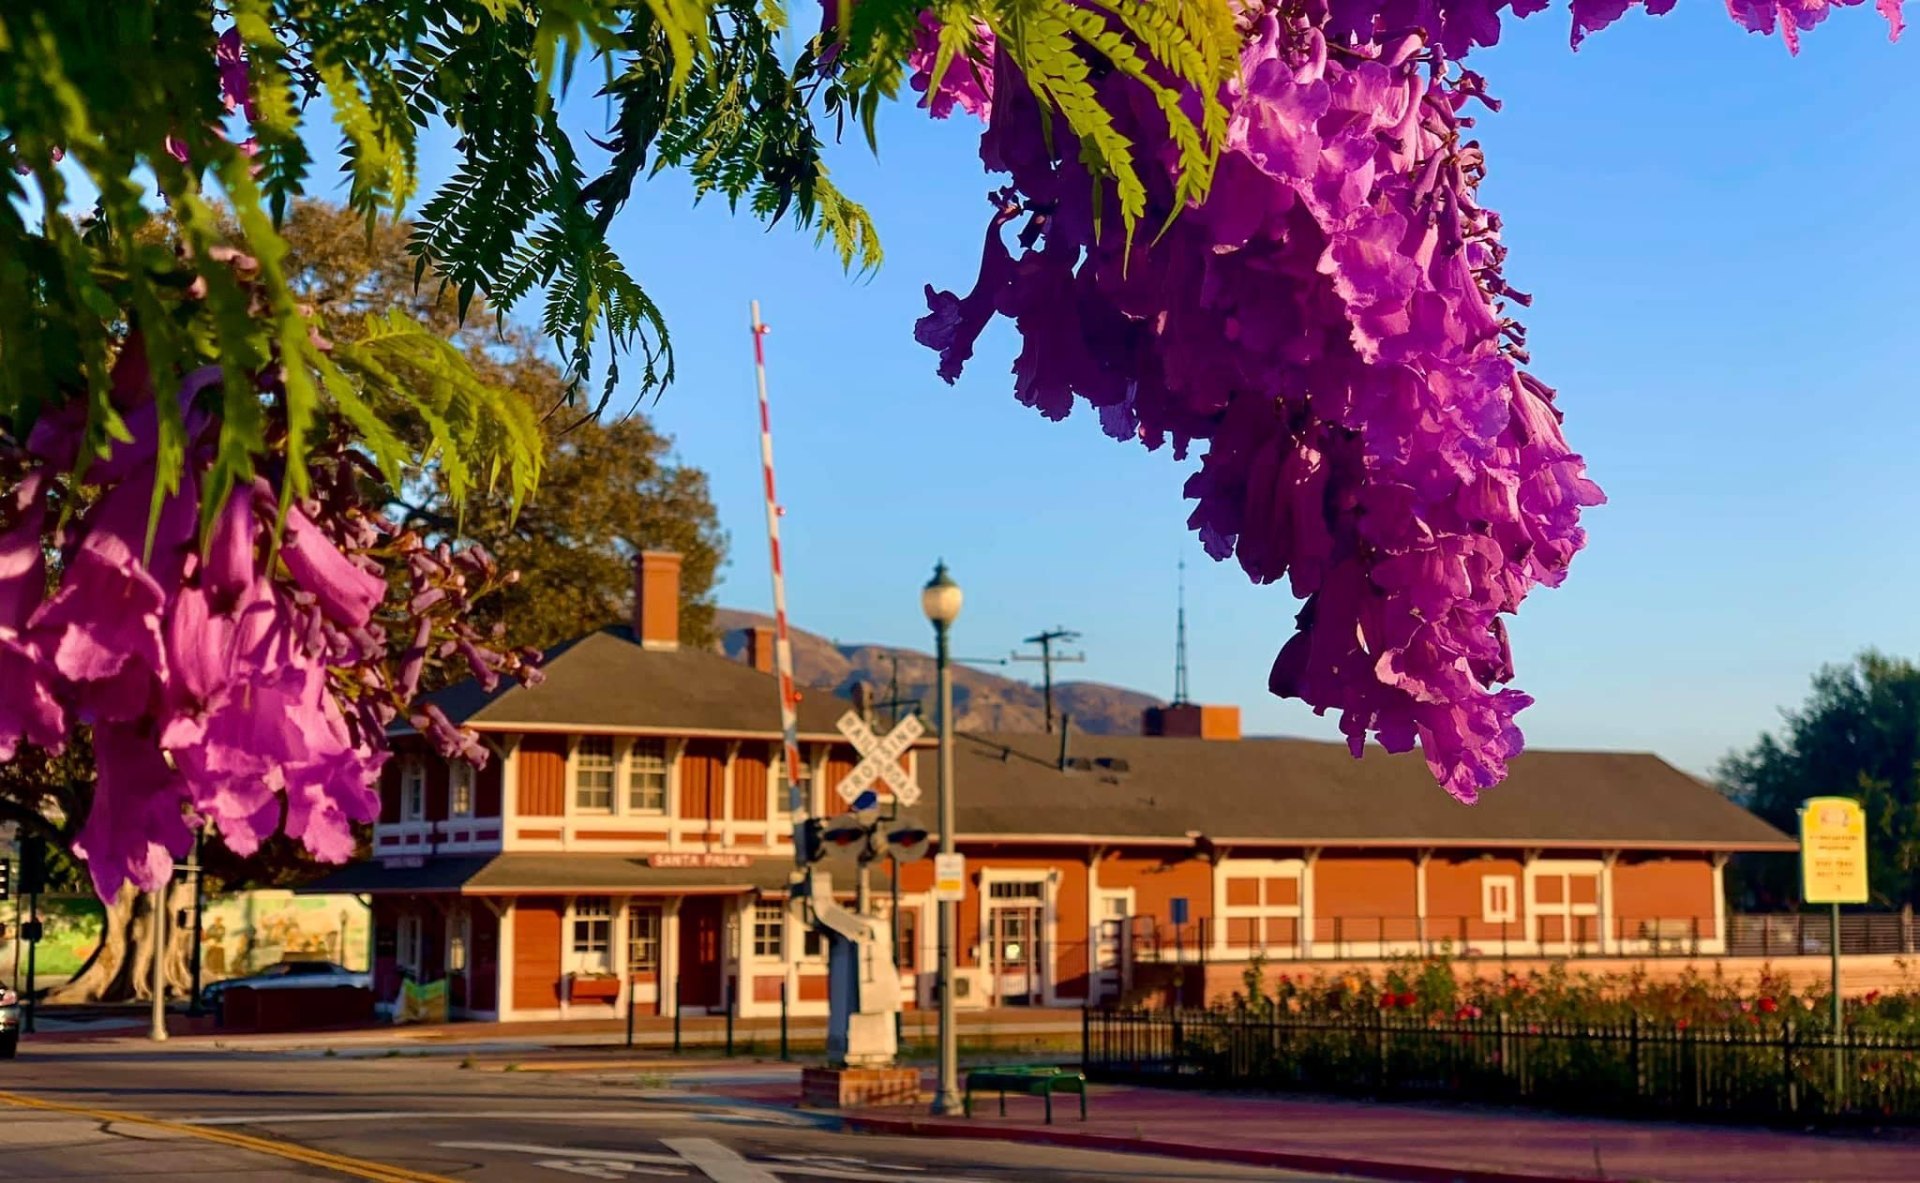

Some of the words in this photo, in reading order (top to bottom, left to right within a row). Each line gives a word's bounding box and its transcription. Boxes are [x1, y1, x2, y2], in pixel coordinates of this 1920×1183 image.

[840, 719, 919, 799] CROSSING
[655, 854, 699, 867] SANTA
[705, 854, 748, 867] PAULA
